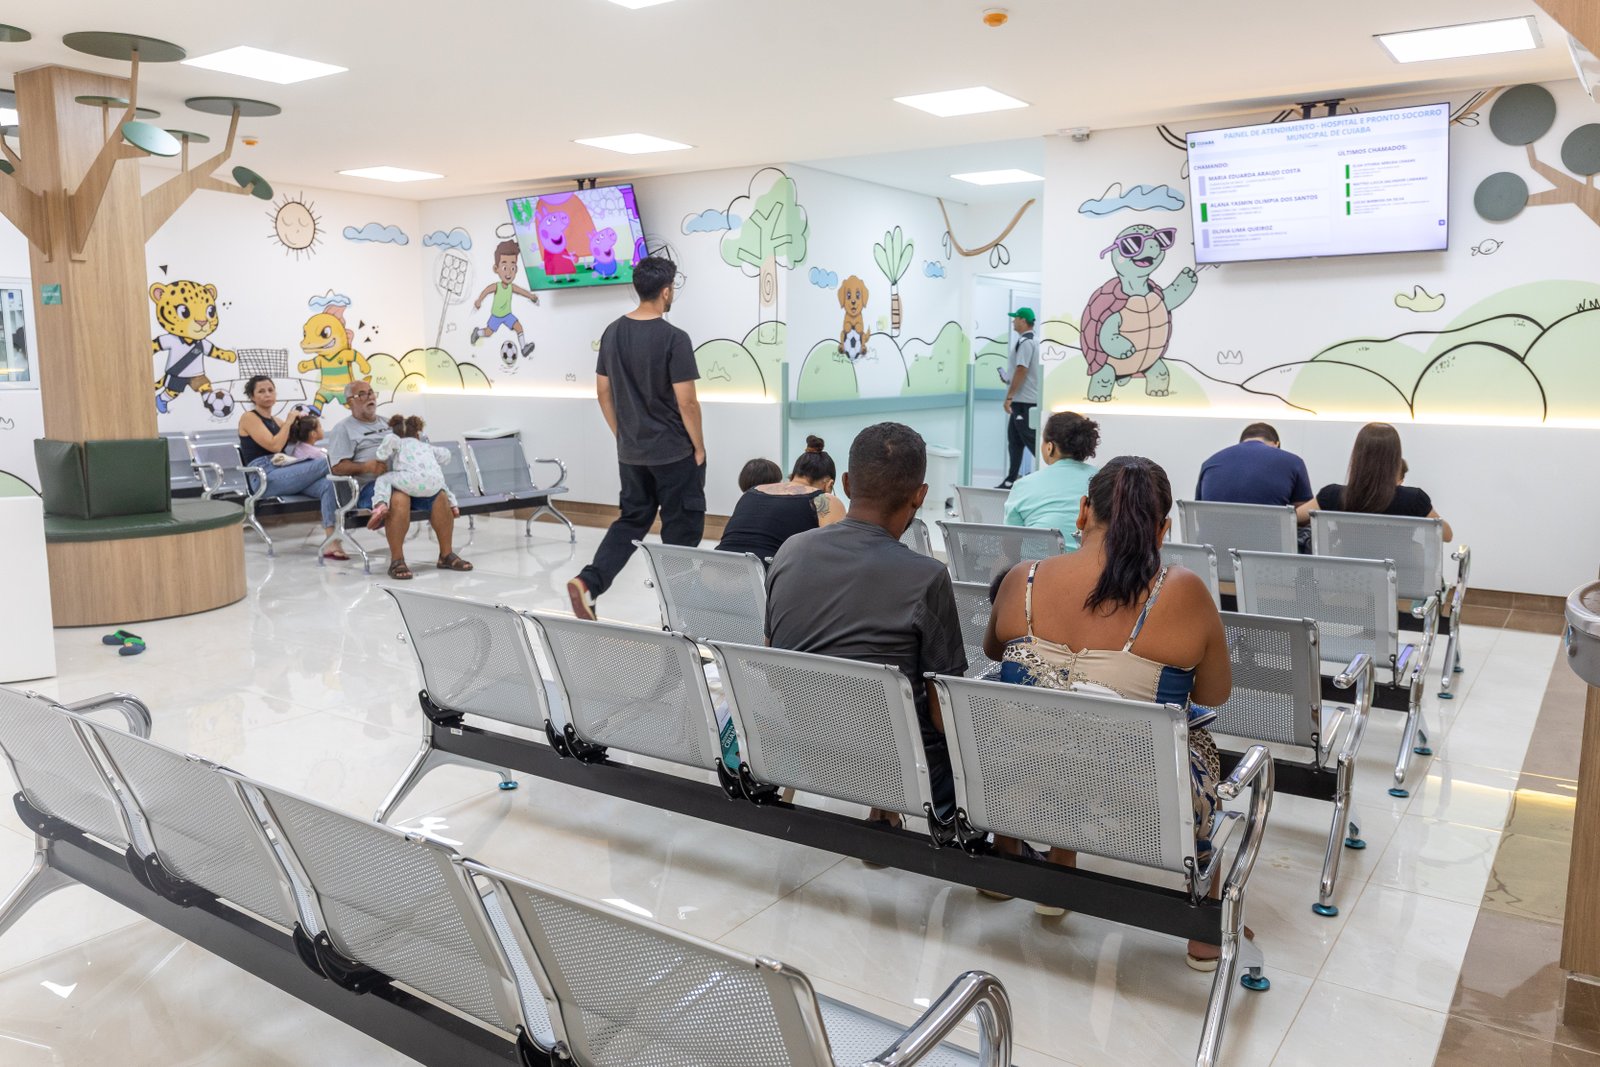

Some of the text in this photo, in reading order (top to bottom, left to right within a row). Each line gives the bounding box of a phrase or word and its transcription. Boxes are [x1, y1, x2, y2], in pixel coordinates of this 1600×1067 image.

[1223, 132, 1249, 140] PAINEL
[1260, 124, 1315, 136] ATENDIMENTO
[1321, 119, 1358, 129] HOSPITAL
[1366, 113, 1400, 123] PRONTO
[1401, 108, 1442, 120] SOCORRO
[1286, 130, 1328, 141] MUNICIPAL
[1330, 129, 1340, 137] DE
[1228, 172, 1256, 180] EDUARDA
